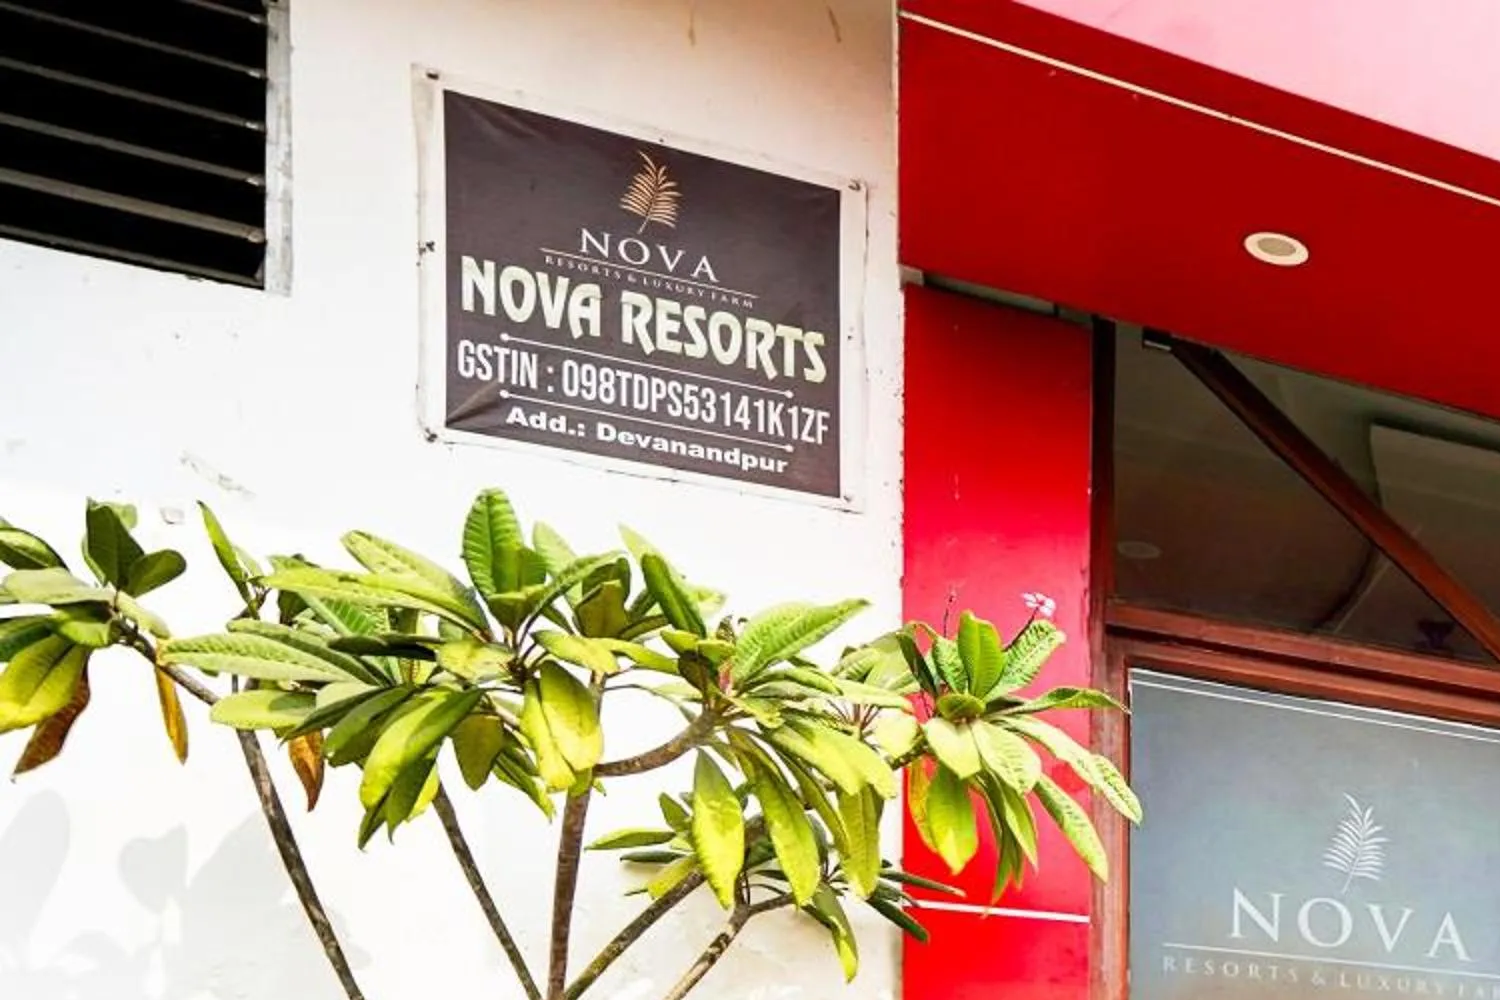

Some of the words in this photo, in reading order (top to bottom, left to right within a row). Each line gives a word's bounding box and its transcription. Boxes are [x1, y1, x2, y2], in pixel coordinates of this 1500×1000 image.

[545, 255, 622, 281] RESORTS
[642, 276, 704, 299] LUXURY
[578, 228, 720, 282] NOVA
[461, 255, 603, 339] NOVA
[620, 289, 827, 383] RESORTS
[458, 339, 539, 390] GSTIN
[505, 406, 586, 437] Add.:
[596, 421, 789, 474] Devanandpur
[1228, 886, 1474, 963] NOVA
[1162, 954, 1299, 984] RESORTS
[1339, 970, 1445, 996] LUXURY
